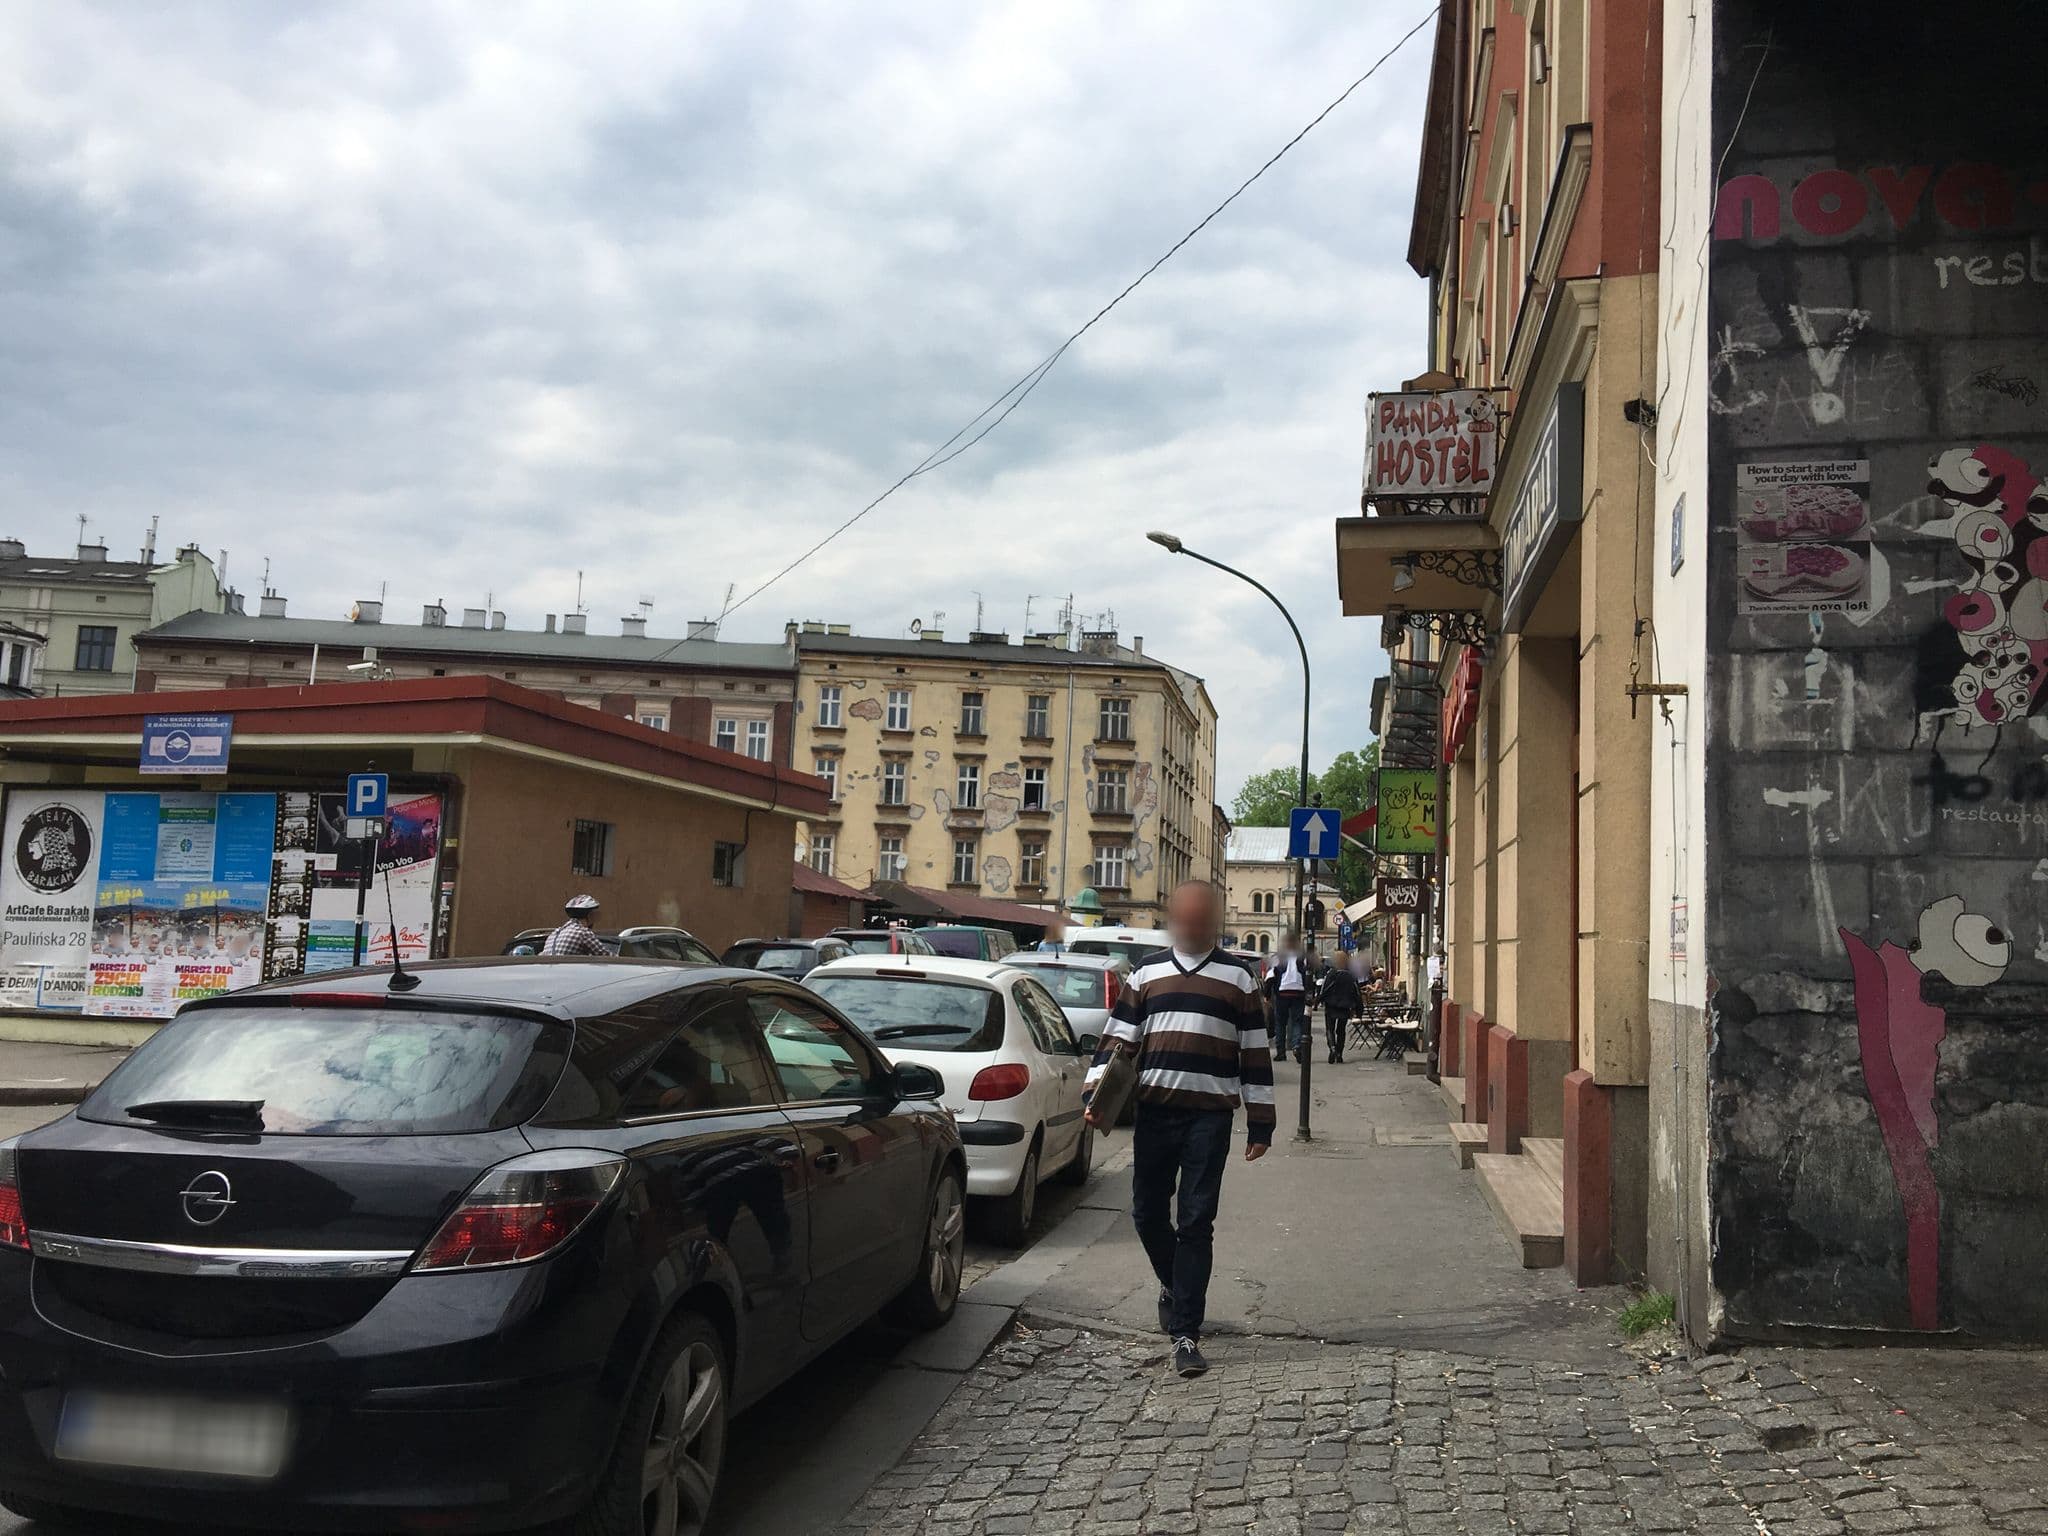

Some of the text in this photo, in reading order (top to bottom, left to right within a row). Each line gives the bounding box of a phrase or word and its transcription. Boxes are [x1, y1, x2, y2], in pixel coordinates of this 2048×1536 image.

[1380, 399, 1460, 437] PANDA
[1376, 434, 1490, 487] HOSTEL
[1747, 462, 1857, 475] How to start and end
[1755, 471, 1852, 485] your day with love.
[1811, 602, 1842, 611] nova
[355, 779, 379, 812] P
[376, 856, 414, 872] Voo Voo
[6, 904, 90, 916] ArtCafe Barakah
[3, 930, 87, 947] Paulińska 28
[89, 963, 147, 973] MARSZ DLA
[174, 964, 234, 975] MARSZ DLA
[8, 977, 38, 989] DEUM
[92, 985, 144, 997] RODZINY
[350, 1261, 389, 1273] GTC
